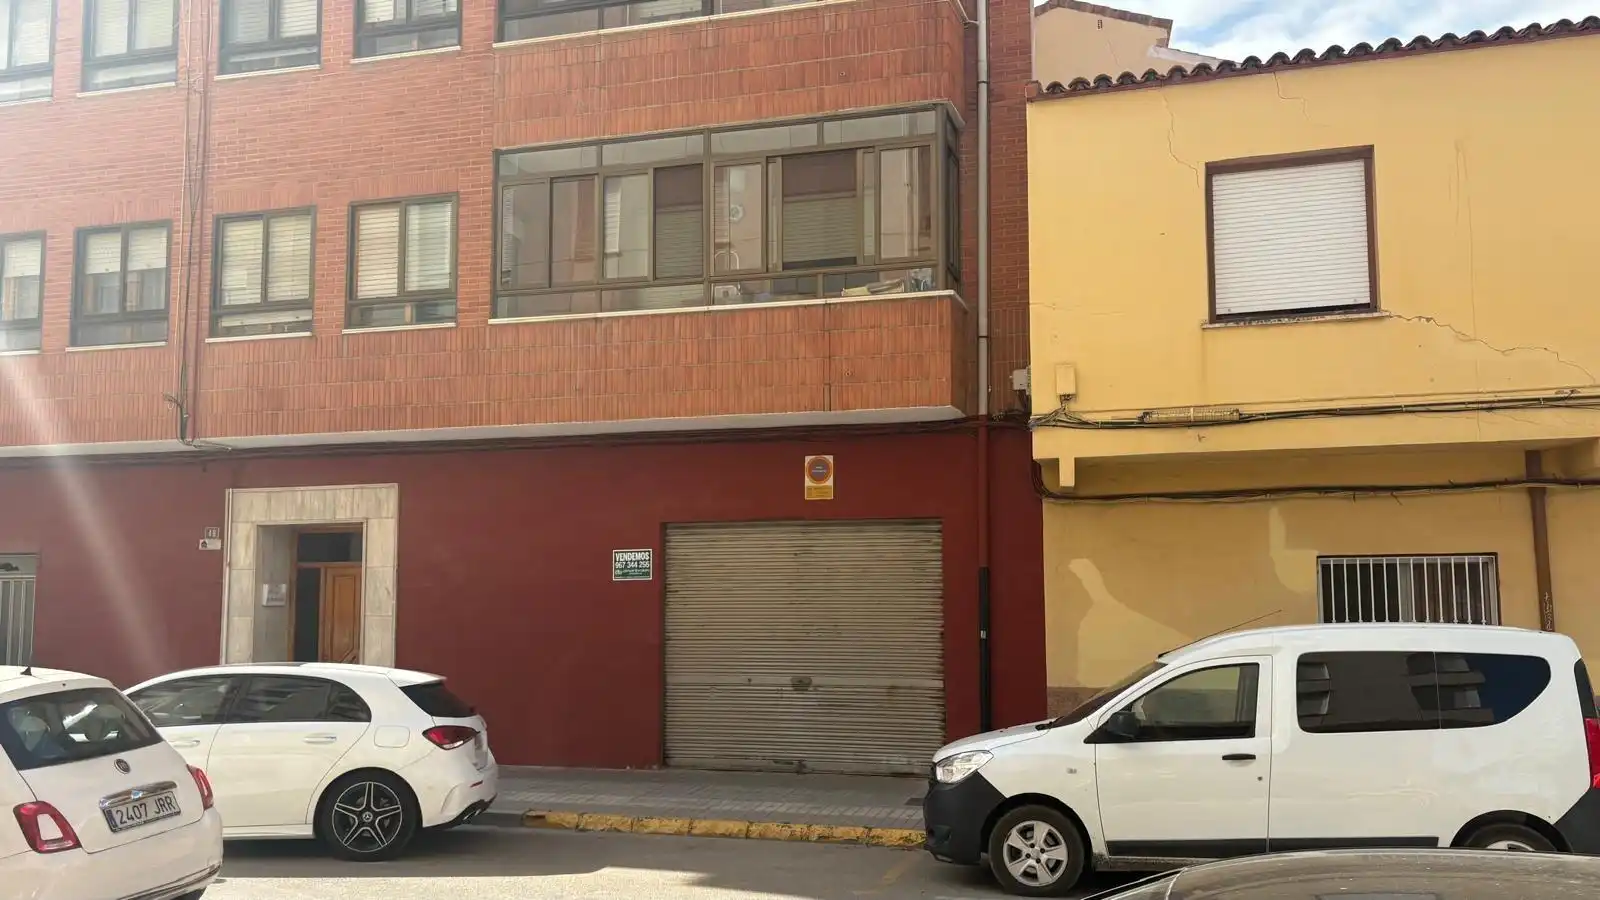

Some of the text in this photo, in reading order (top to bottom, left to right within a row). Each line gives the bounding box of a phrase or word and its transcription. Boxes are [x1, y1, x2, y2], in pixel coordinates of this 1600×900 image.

[615, 552, 650, 562] VENDEMOS
[626, 561, 638, 569] 344
[115, 796, 176, 825] 2407 JRR
